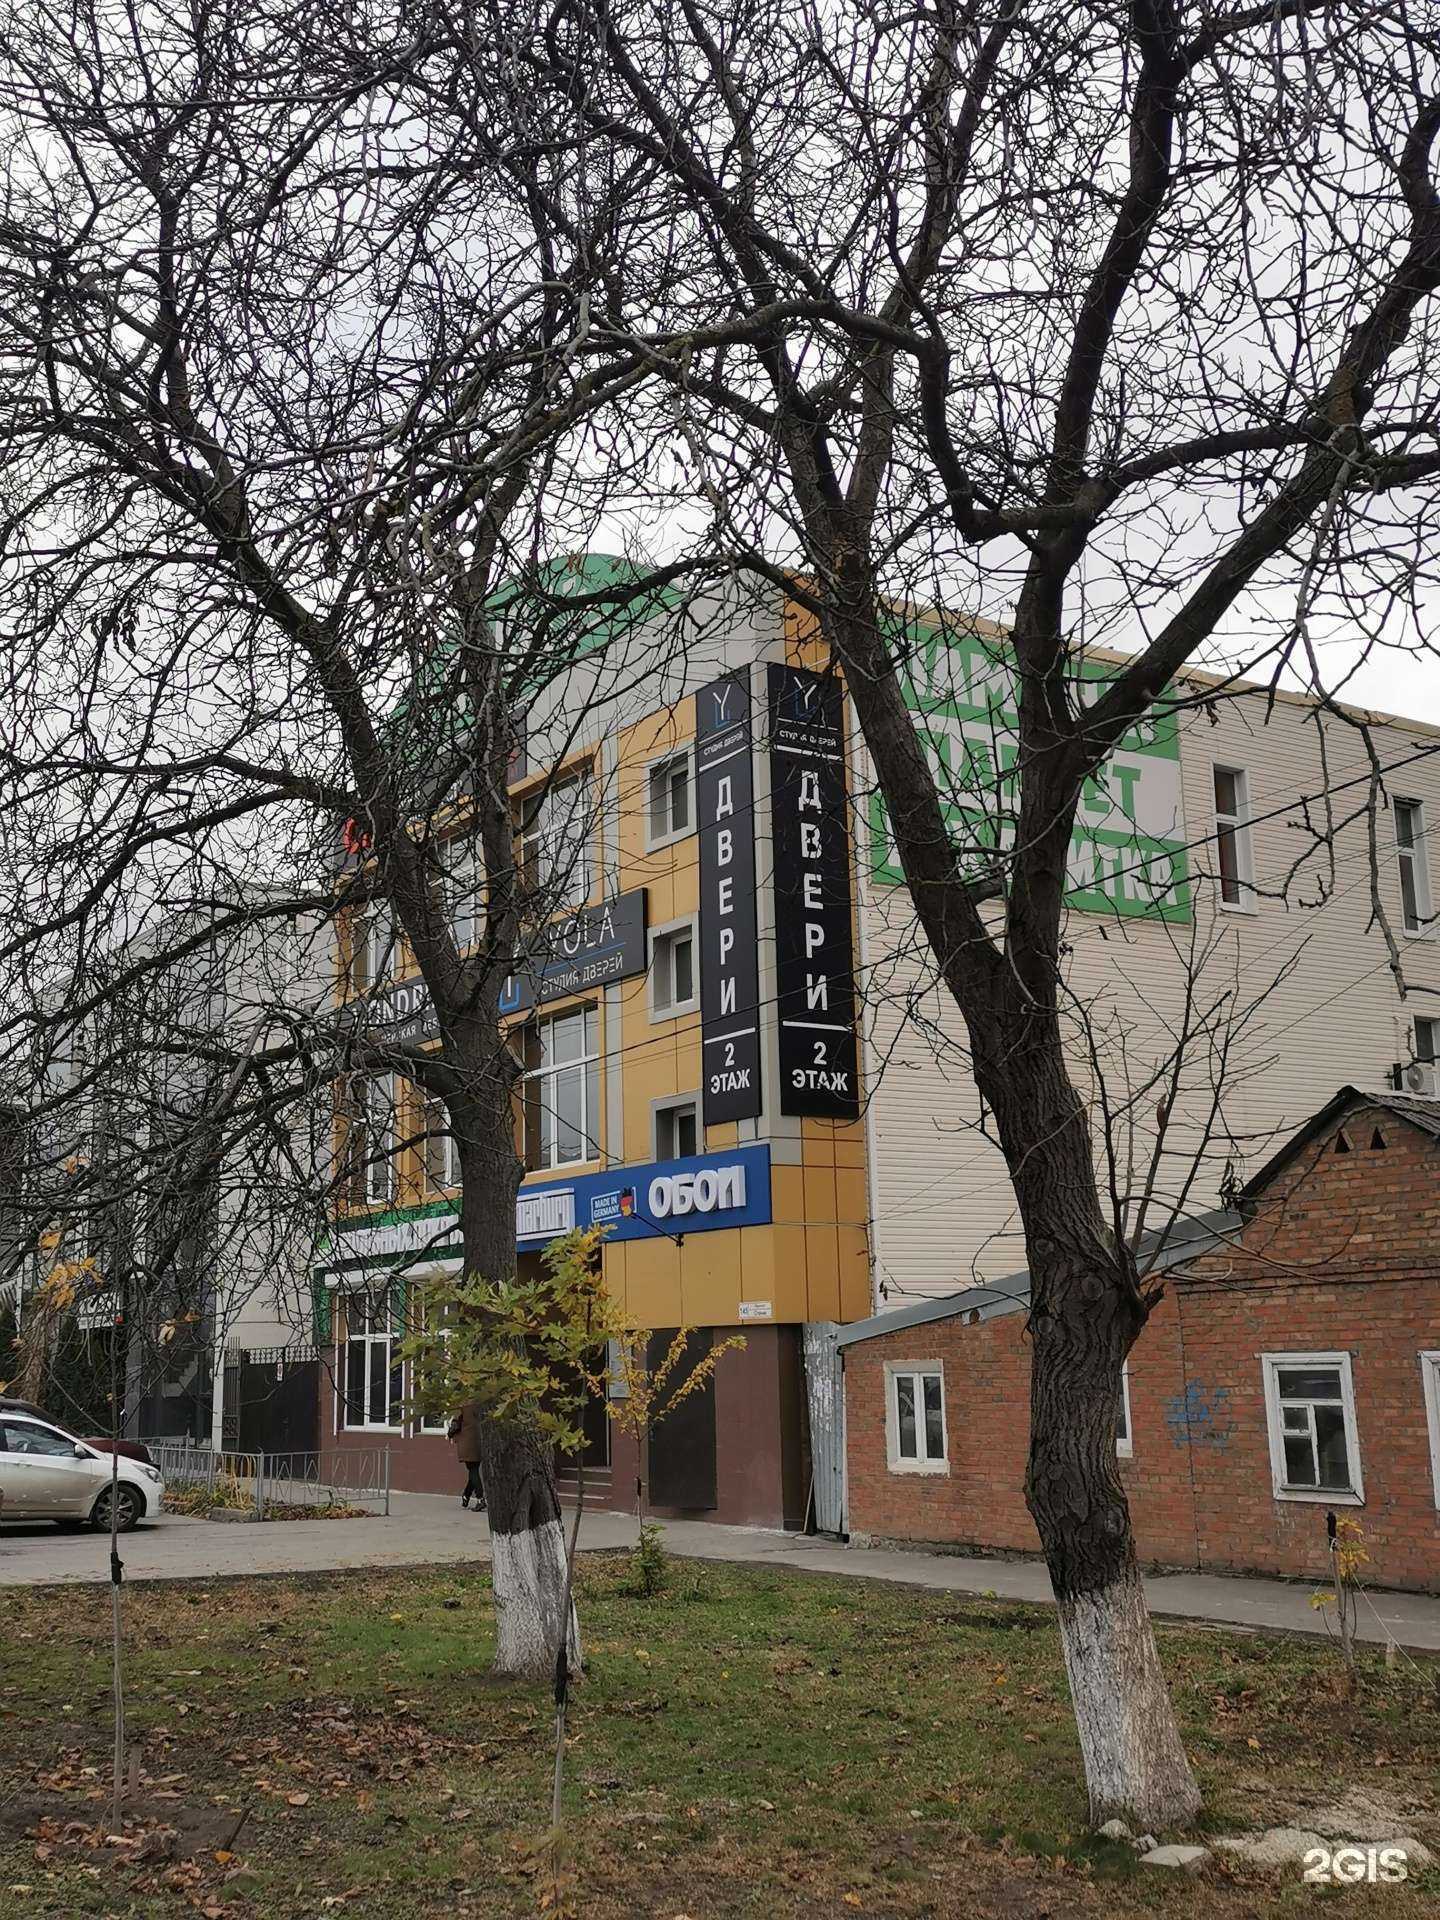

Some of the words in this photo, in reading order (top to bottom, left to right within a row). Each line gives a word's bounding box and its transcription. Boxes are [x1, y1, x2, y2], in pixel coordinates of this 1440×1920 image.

[716, 775, 736, 1016] ДВЕРИ
[798, 770, 828, 1011] ДВЕРИ
[541, 971, 579, 995] СТУДИЯ
[582, 952, 624, 984] ДВЕРЕЙ
[724, 1042, 735, 1067] 2
[814, 1041, 827, 1065] 2
[710, 1068, 751, 1094] ЭТАЖ
[791, 1068, 849, 1092] ЭТАЖ
[648, 1165, 747, 1219] ОБОИ
